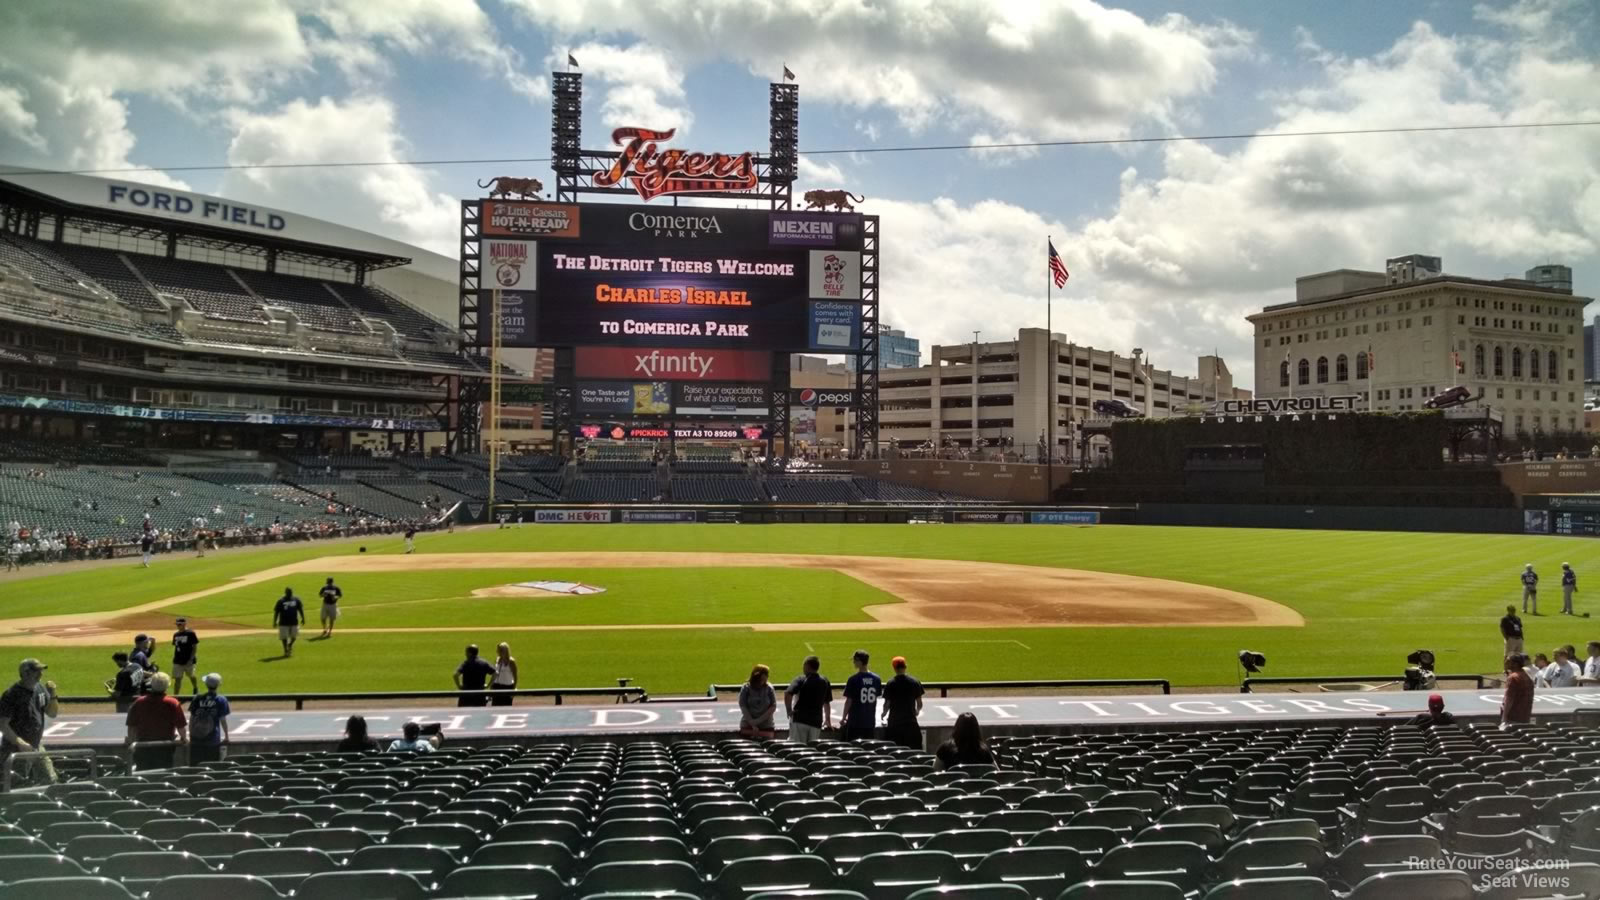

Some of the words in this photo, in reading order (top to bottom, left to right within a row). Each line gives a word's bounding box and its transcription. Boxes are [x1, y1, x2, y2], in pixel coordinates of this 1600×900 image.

[593, 126, 758, 202] Tigers
[109, 184, 194, 214] FORD
[203, 201, 286, 231] FIELD
[507, 206, 531, 217] Little
[532, 207, 567, 218] Caesars
[491, 216, 570, 230] HOT-N-READY
[773, 220, 834, 234] NEXEN
[654, 229, 699, 239] PARK
[490, 242, 528, 258] NATIONAL
[815, 302, 854, 310] Confidence
[634, 350, 714, 377] xfinity
[683, 385, 702, 394] Raise
[704, 387, 720, 395] your
[721, 386, 764, 395] expectations
[685, 394, 693, 402] of
[693, 394, 711, 402] what
[818, 392, 852, 404] pepsi
[1223, 395, 1362, 413] CHEVROLET
[1200, 414, 1336, 424] FOUNTAIN
[630, 429, 669, 437] #PICKRICK
[714, 430, 738, 438] 89269
[538, 512, 564, 521] DMC
[1064, 514, 1090, 522] Energy
[860, 687, 876, 703] 66
[1058, 697, 1392, 717] TIGERS
